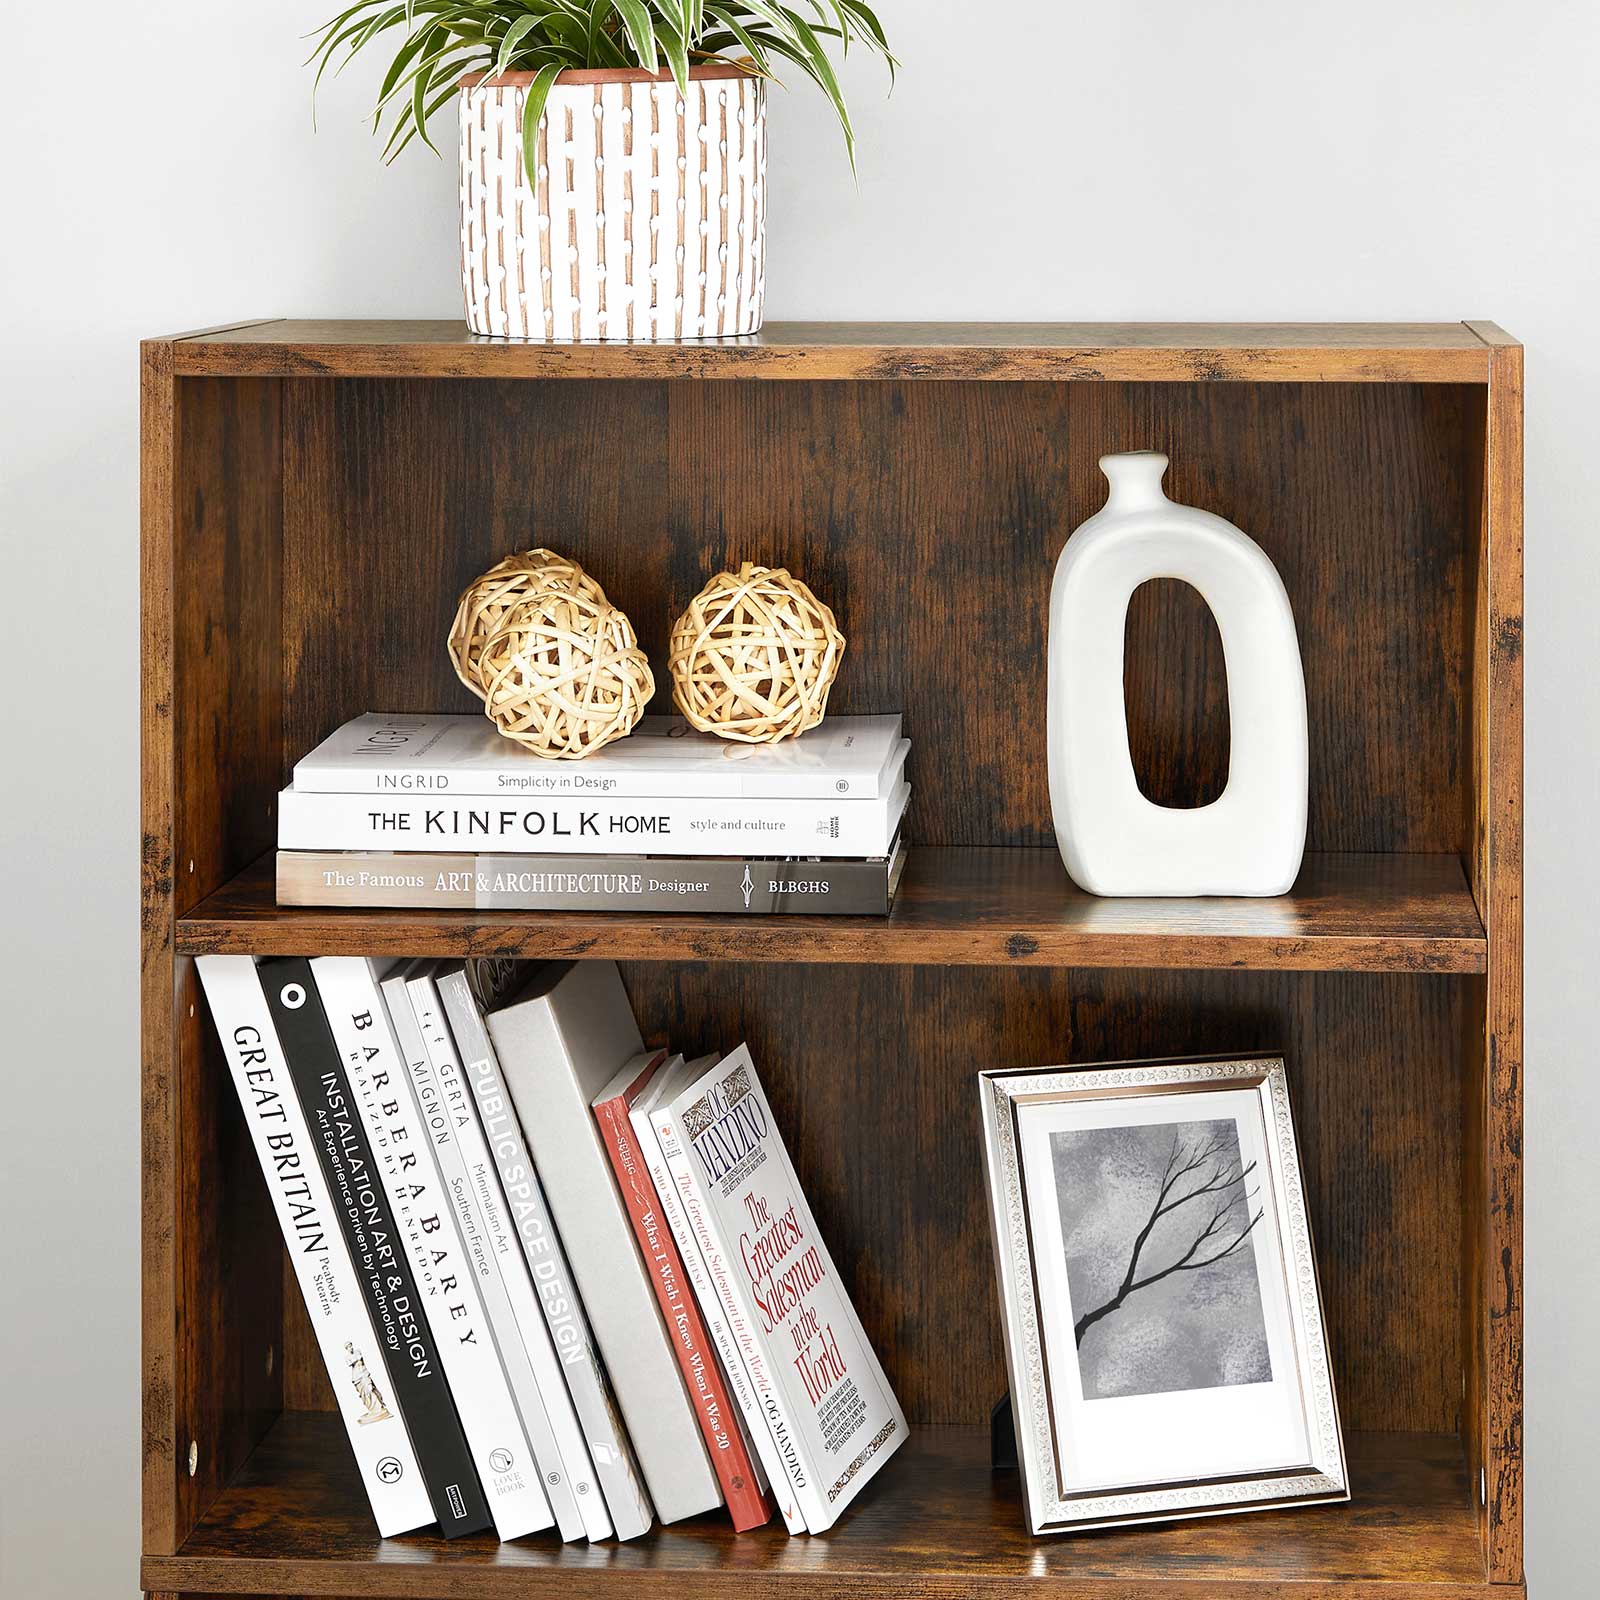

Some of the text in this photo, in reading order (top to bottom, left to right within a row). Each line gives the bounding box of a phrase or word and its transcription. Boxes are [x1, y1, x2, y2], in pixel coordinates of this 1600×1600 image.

[378, 774, 448, 788] INGRID
[498, 774, 616, 790] Simplicity in Design
[368, 810, 670, 835] THE KINFOLK HOME
[690, 819, 785, 832] style and culture
[323, 871, 709, 894] The Famous ART & ARCHITECTURE Designer
[768, 881, 830, 894] BLBGHS
[412, 1061, 450, 1145] MIGNON
[440, 1064, 469, 1127] GERTA
[233, 1026, 328, 1252] GREAT BRITAIN
[693, 1093, 767, 1188] MANDINO
[350, 1052, 437, 1295] REALIZED BY HENREDON
[352, 1010, 476, 1344] BARBERA BAREY
[316, 1109, 400, 1350] Art Experience Driven by Technology
[321, 1072, 431, 1377] INSTALLATION ART & DESIGN
[451, 1177, 489, 1276] Southern France
[470, 1058, 517, 1159] PUBLIC
[504, 1164, 549, 1256] SPACE
[535, 1260, 584, 1366] DESIGN
[473, 1163, 509, 1254] Minimalism Art
[641, 1211, 659, 1250] What
[653, 1166, 706, 1290] WHO MOVED MY CHEESE?
[744, 1191, 771, 1233] The
[655, 1253, 667, 1261] I
[739, 1197, 804, 1284] Greatest
[313, 1274, 332, 1316] Stearns
[319, 1257, 340, 1303] Peabody
[660, 1263, 679, 1300] Wish
[752, 1245, 826, 1336] Salesman
[671, 1303, 683, 1311] I
[677, 1172, 806, 1488] The Greatest Salesman in the World OG MANDINO
[787, 1302, 821, 1352] in the
[675, 1312, 693, 1349] Knew
[689, 1351, 706, 1392] When
[712, 1321, 752, 1410] DR SPENCER JOHNSON
[793, 1323, 847, 1408] World
[706, 1401, 720, 1431] Was
[715, 1432, 730, 1449] 20
[493, 1471, 522, 1487] LOVE
[496, 1480, 525, 1496] BOOK
